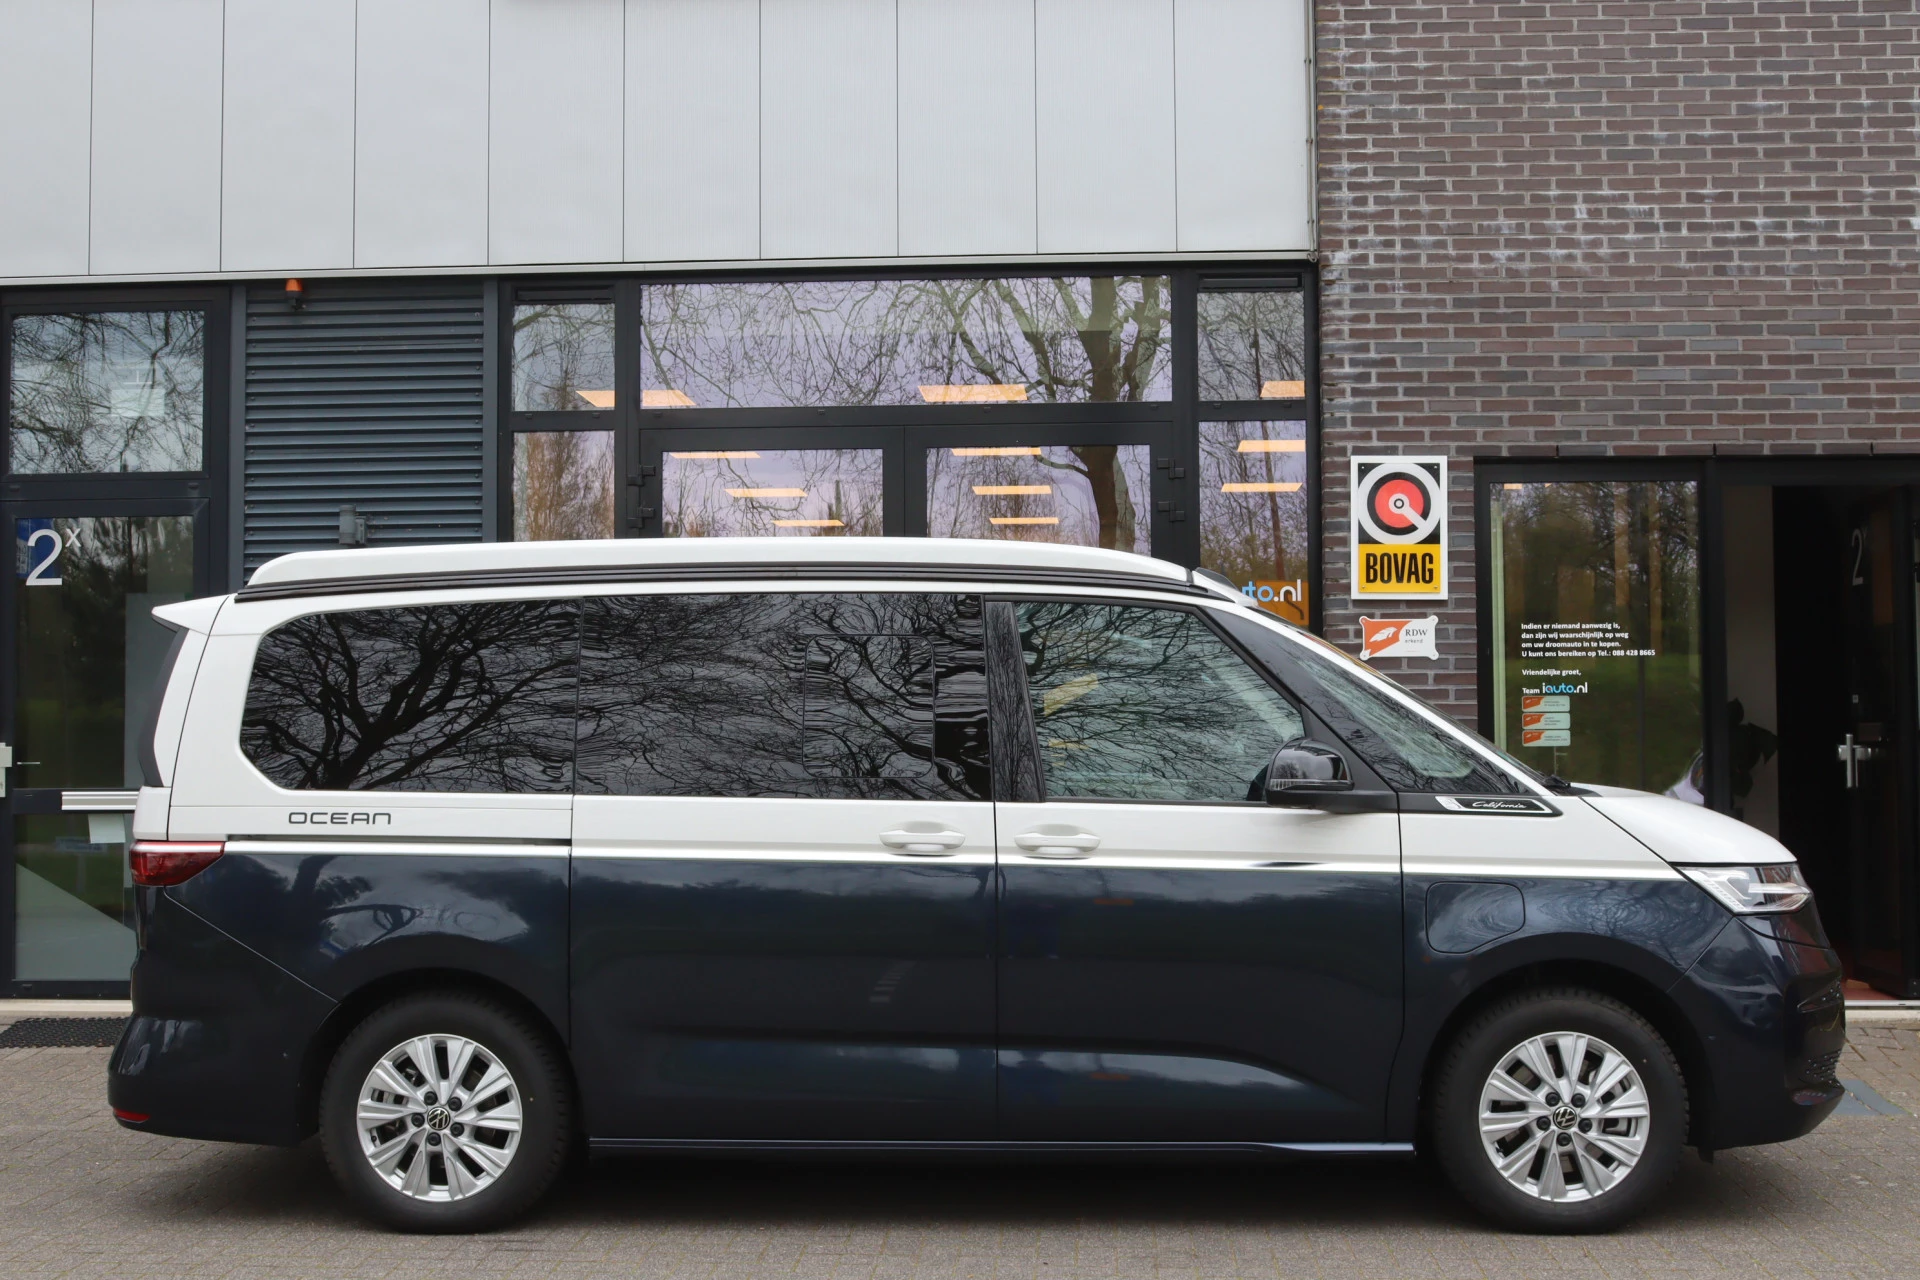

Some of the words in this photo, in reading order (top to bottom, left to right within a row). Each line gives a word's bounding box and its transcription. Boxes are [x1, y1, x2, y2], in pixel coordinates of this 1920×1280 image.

[1365, 552, 1435, 584] BOVAG
[1242, 579, 1302, 602] to.nl
[1521, 622, 1542, 630] Indien
[1581, 622, 1612, 630] aanwezig
[1405, 629, 1428, 637] RDW
[1535, 632, 1547, 640] zijn
[1547, 632, 1559, 640] wij
[1559, 631, 1604, 640] waarschijnlijk
[1521, 669, 1561, 677] Vriendelijke
[1561, 669, 1582, 677] groet,
[1542, 682, 1588, 694] iauto.nl
[1471, 801, 1527, 809] California
[288, 812, 392, 825] OCEAN
